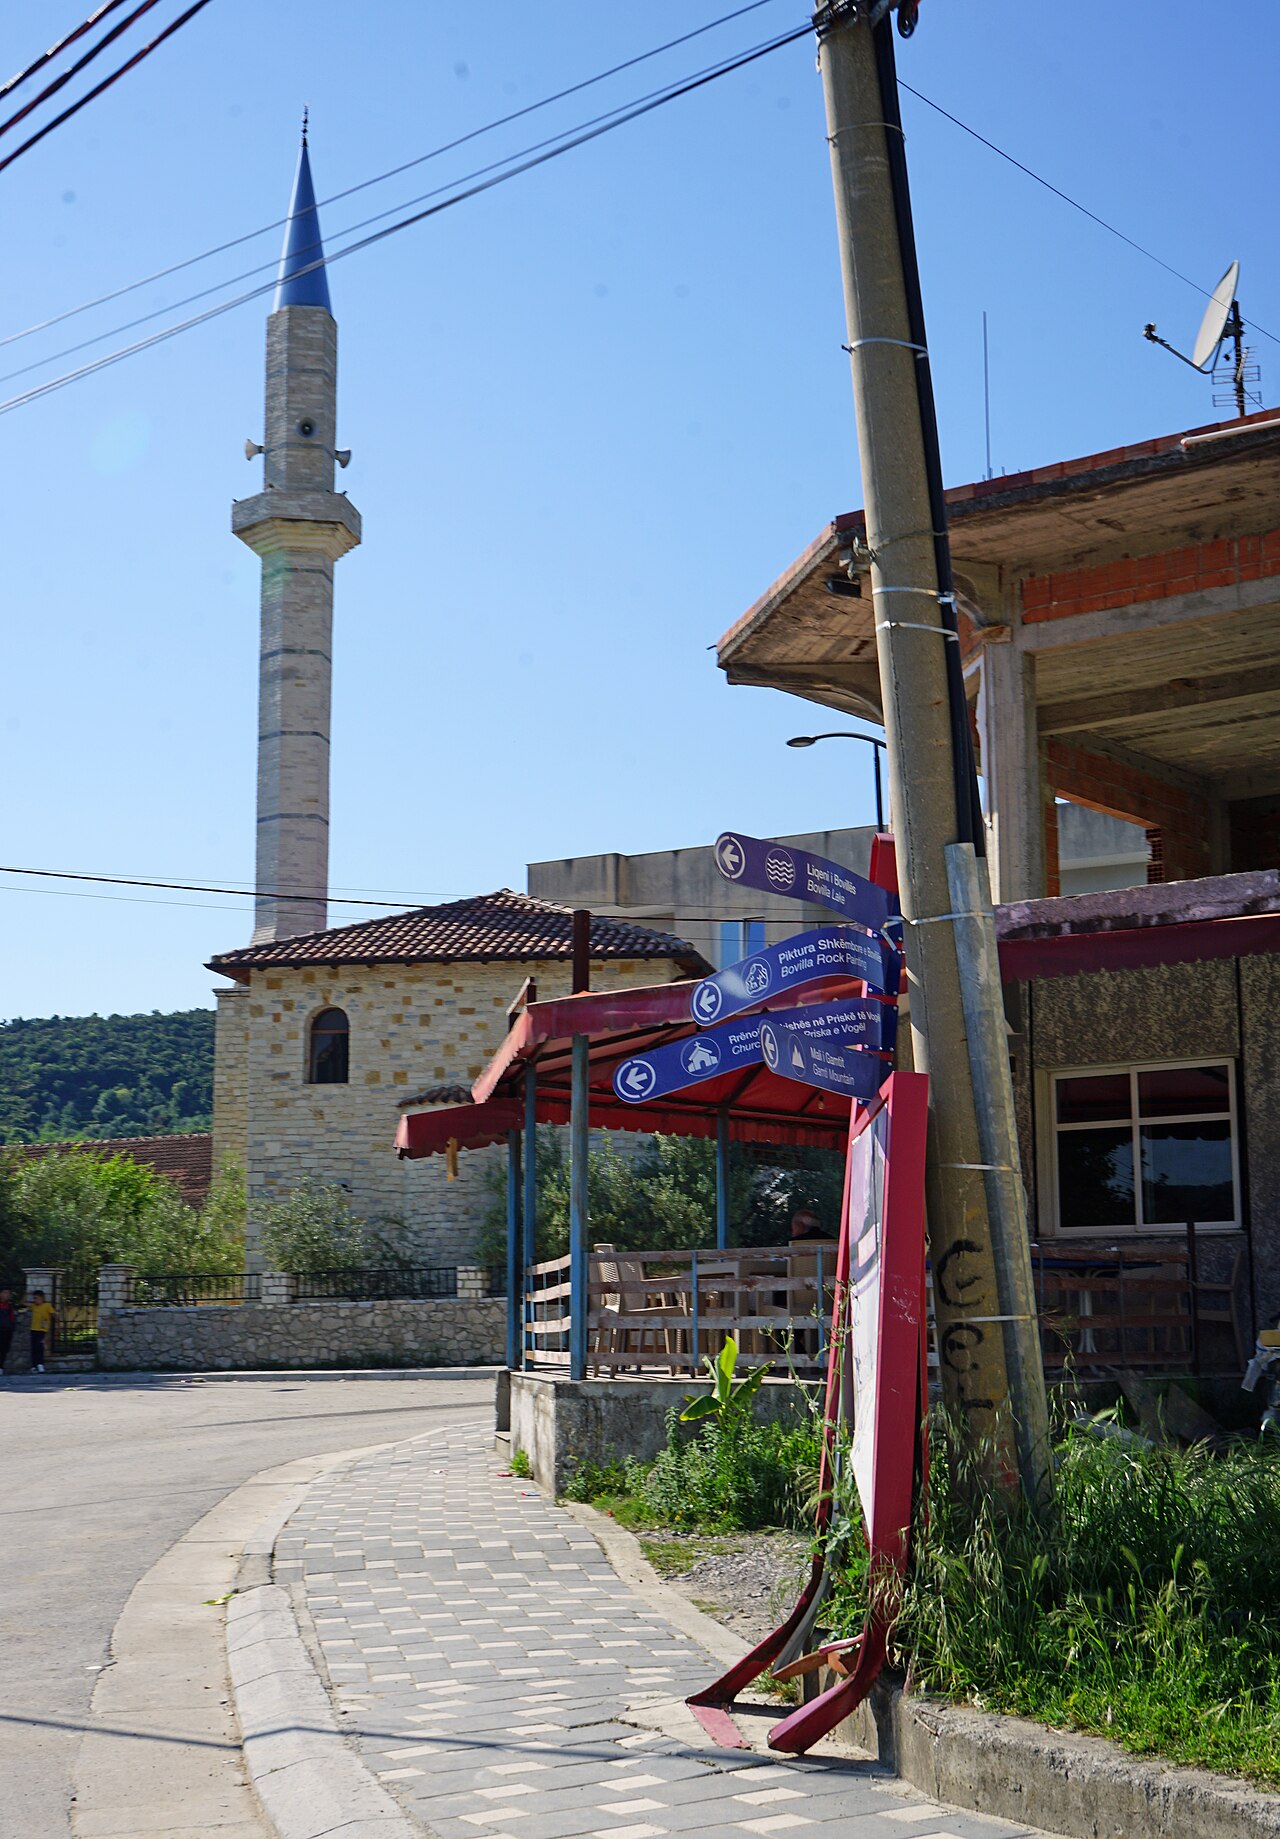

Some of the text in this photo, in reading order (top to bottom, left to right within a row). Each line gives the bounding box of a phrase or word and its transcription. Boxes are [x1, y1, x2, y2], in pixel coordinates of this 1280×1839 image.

[831, 888, 846, 905] Lake
[778, 943, 816, 964] Piktura
[781, 958, 814, 978] Bovilla
[816, 952, 845, 965] Rock
[812, 1016, 825, 1027] në
[826, 1012, 856, 1024] Priskë
[731, 1041, 761, 1055] Churc
[833, 1027, 840, 1035] e
